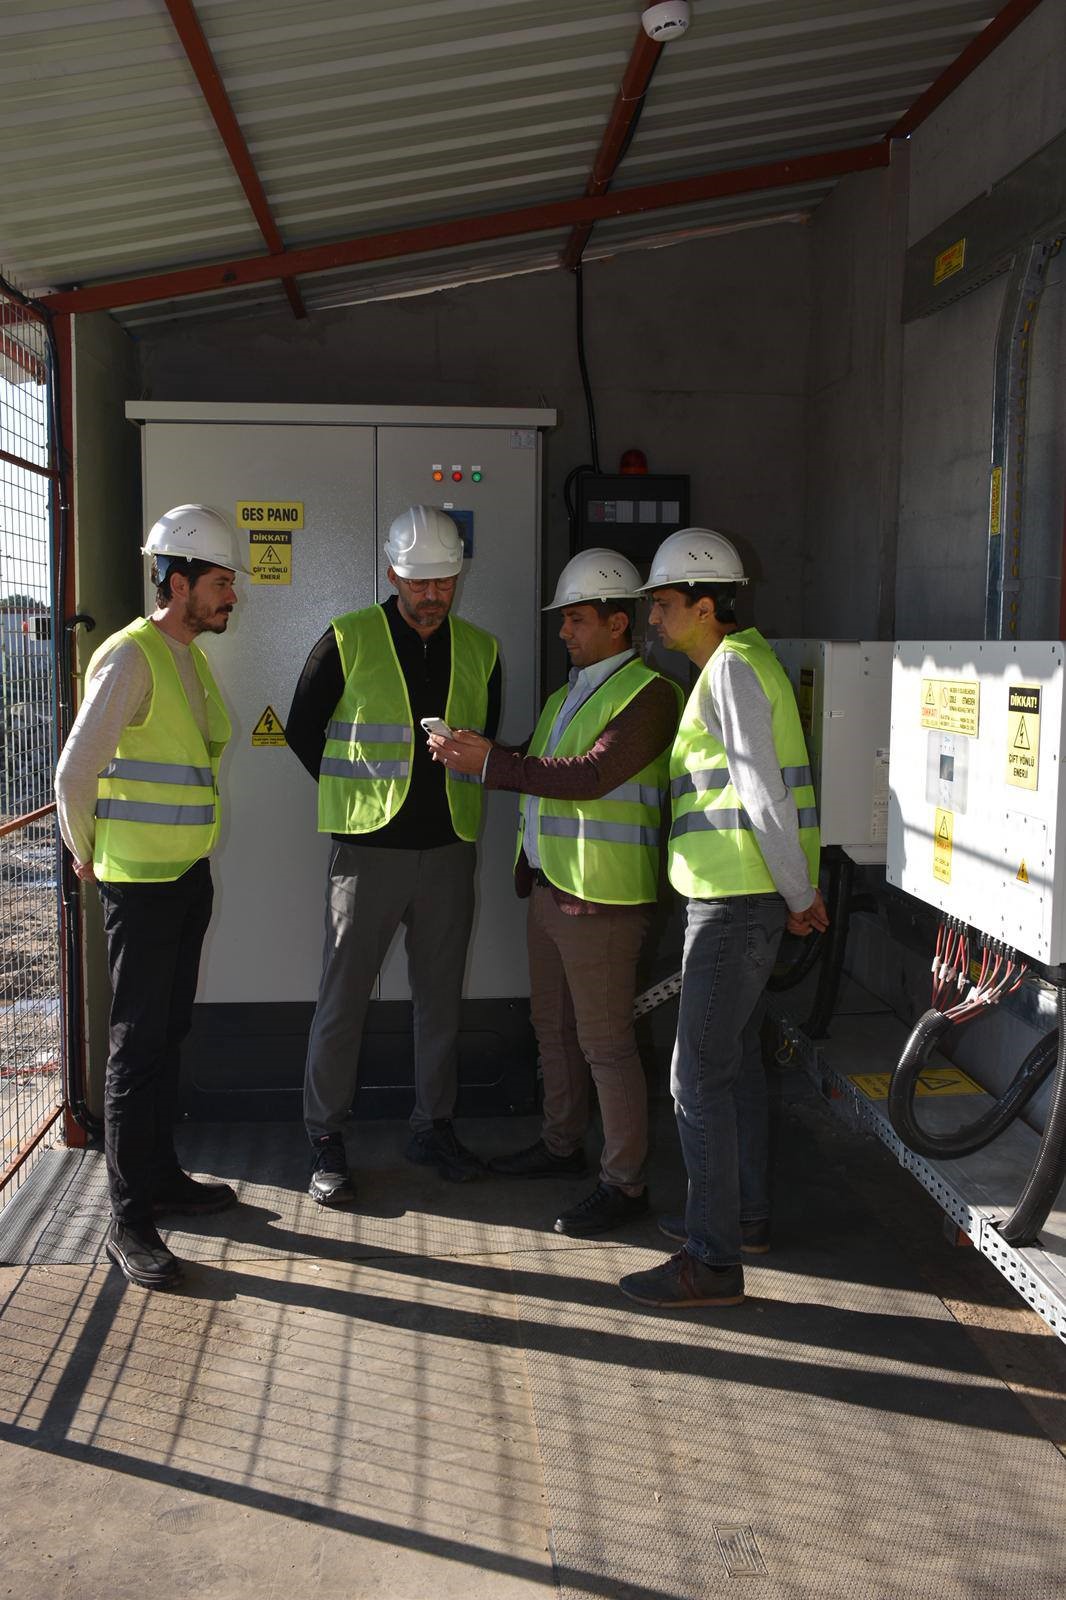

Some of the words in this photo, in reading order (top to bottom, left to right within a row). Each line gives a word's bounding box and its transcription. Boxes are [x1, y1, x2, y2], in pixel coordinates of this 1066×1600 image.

[242, 507, 264, 521] GES
[267, 508, 298, 522] PANO
[252, 533, 288, 542] DİKKAT!
[1010, 693, 1038, 709] DİKKAT!
